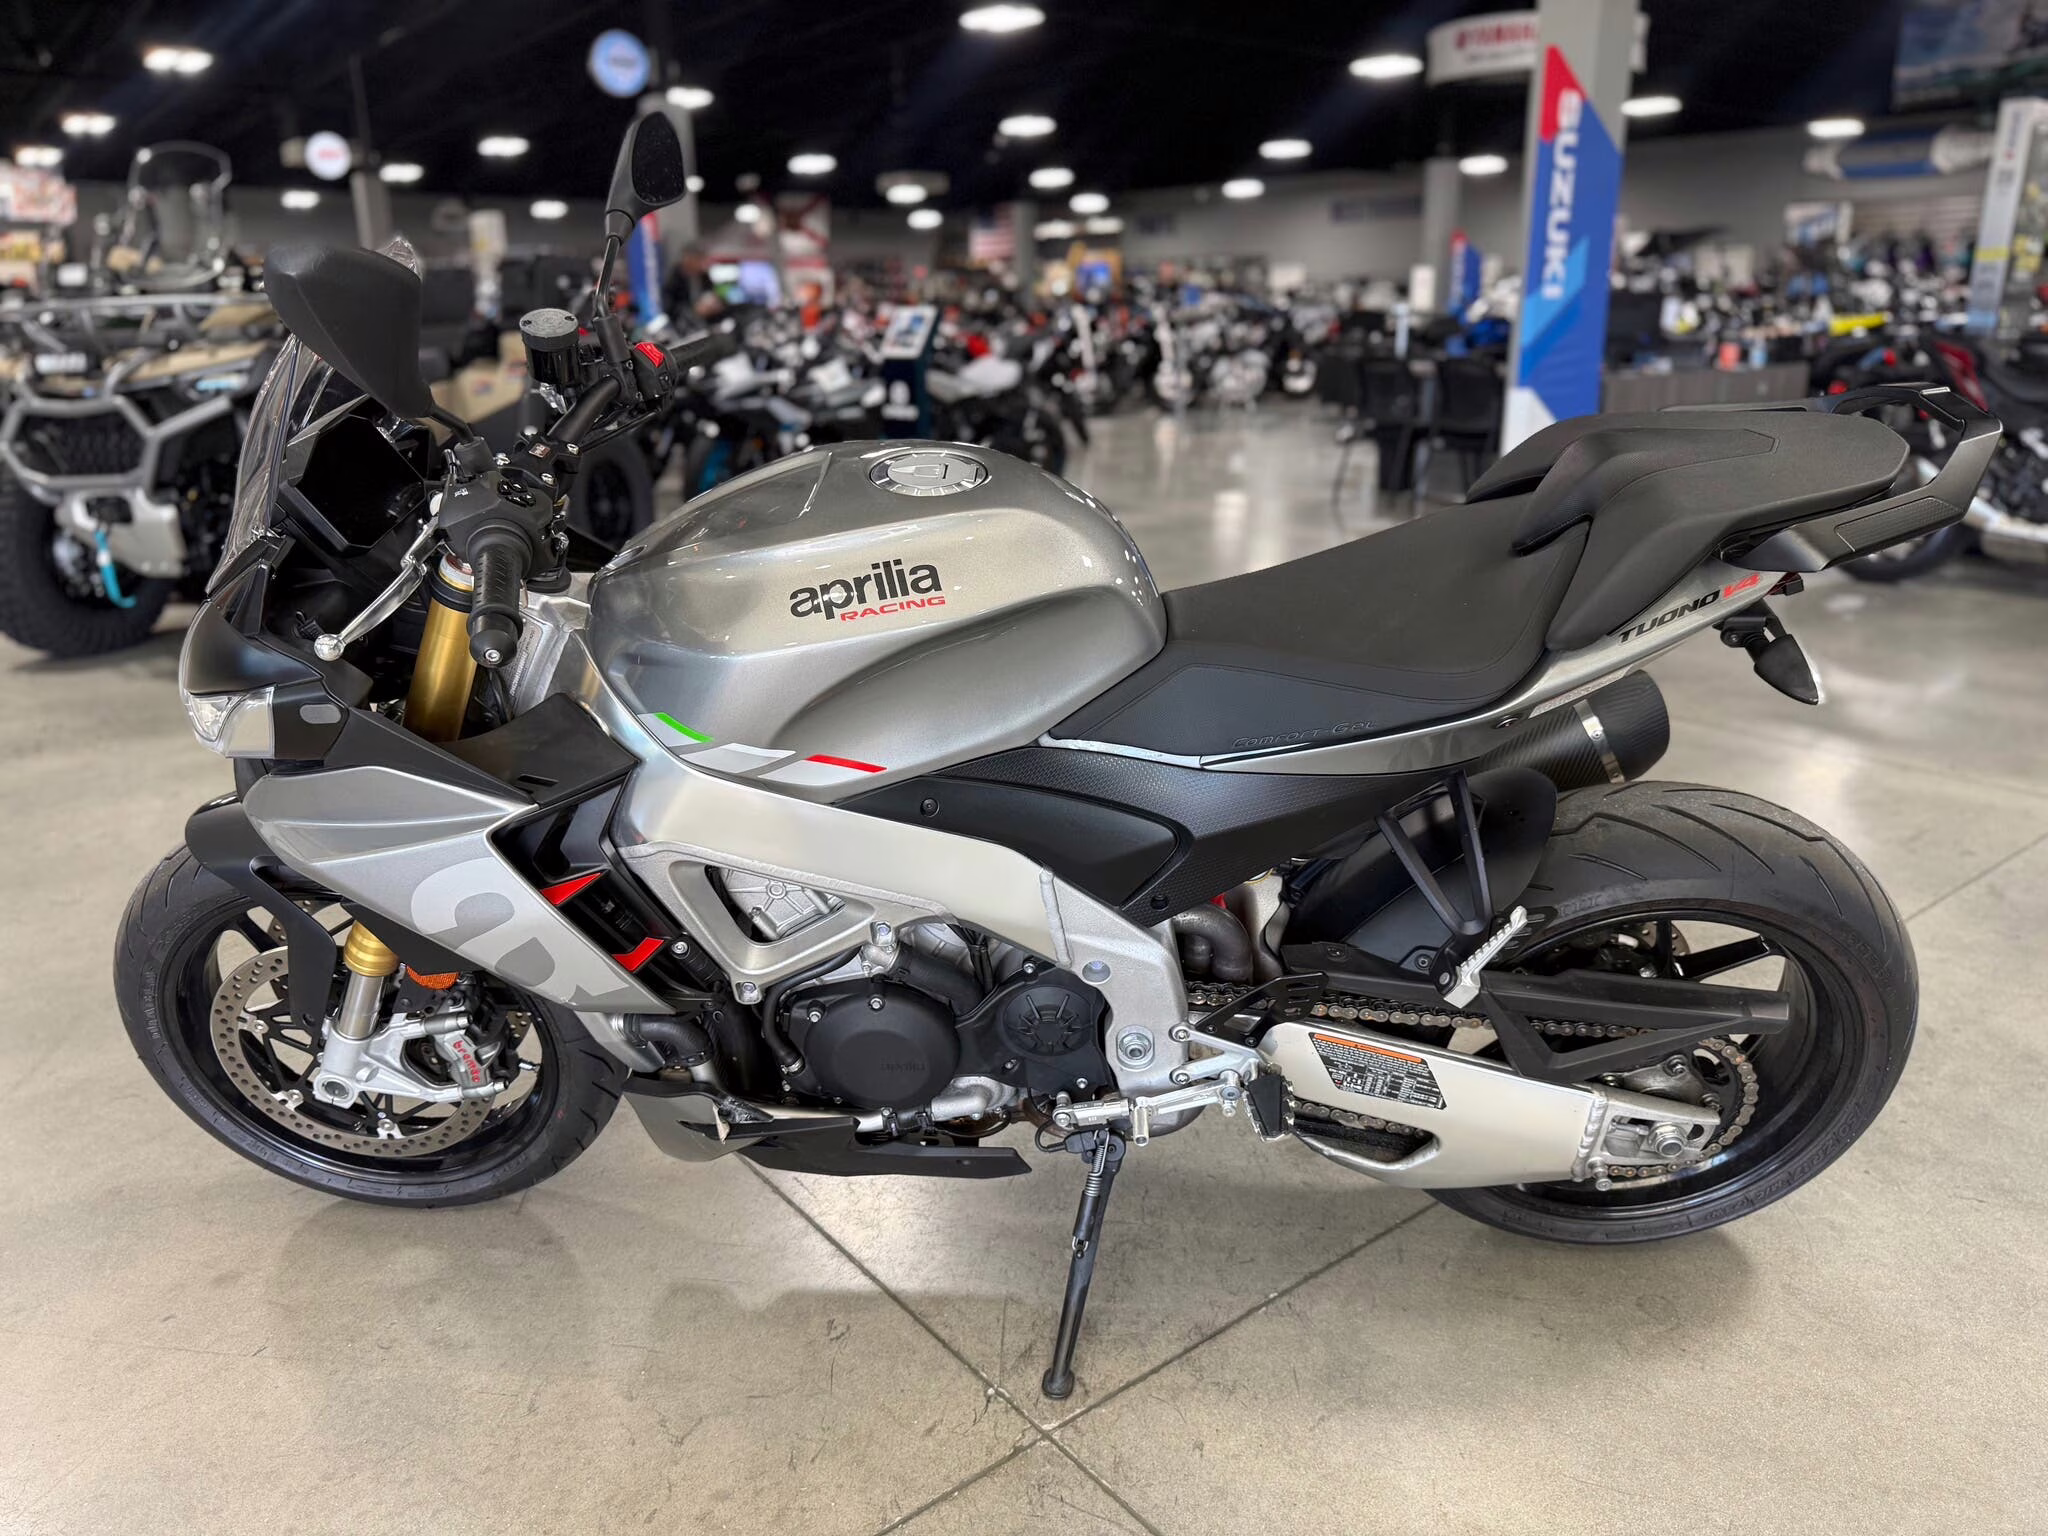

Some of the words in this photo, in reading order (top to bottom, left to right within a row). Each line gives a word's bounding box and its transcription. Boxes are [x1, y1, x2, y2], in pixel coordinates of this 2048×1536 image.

[1541, 88, 1583, 299] SUZUKI
[790, 558, 942, 620] aprilia
[840, 596, 946, 621] RACING
[1619, 589, 1721, 643] TUONO
[453, 1040, 481, 1083] brembo
